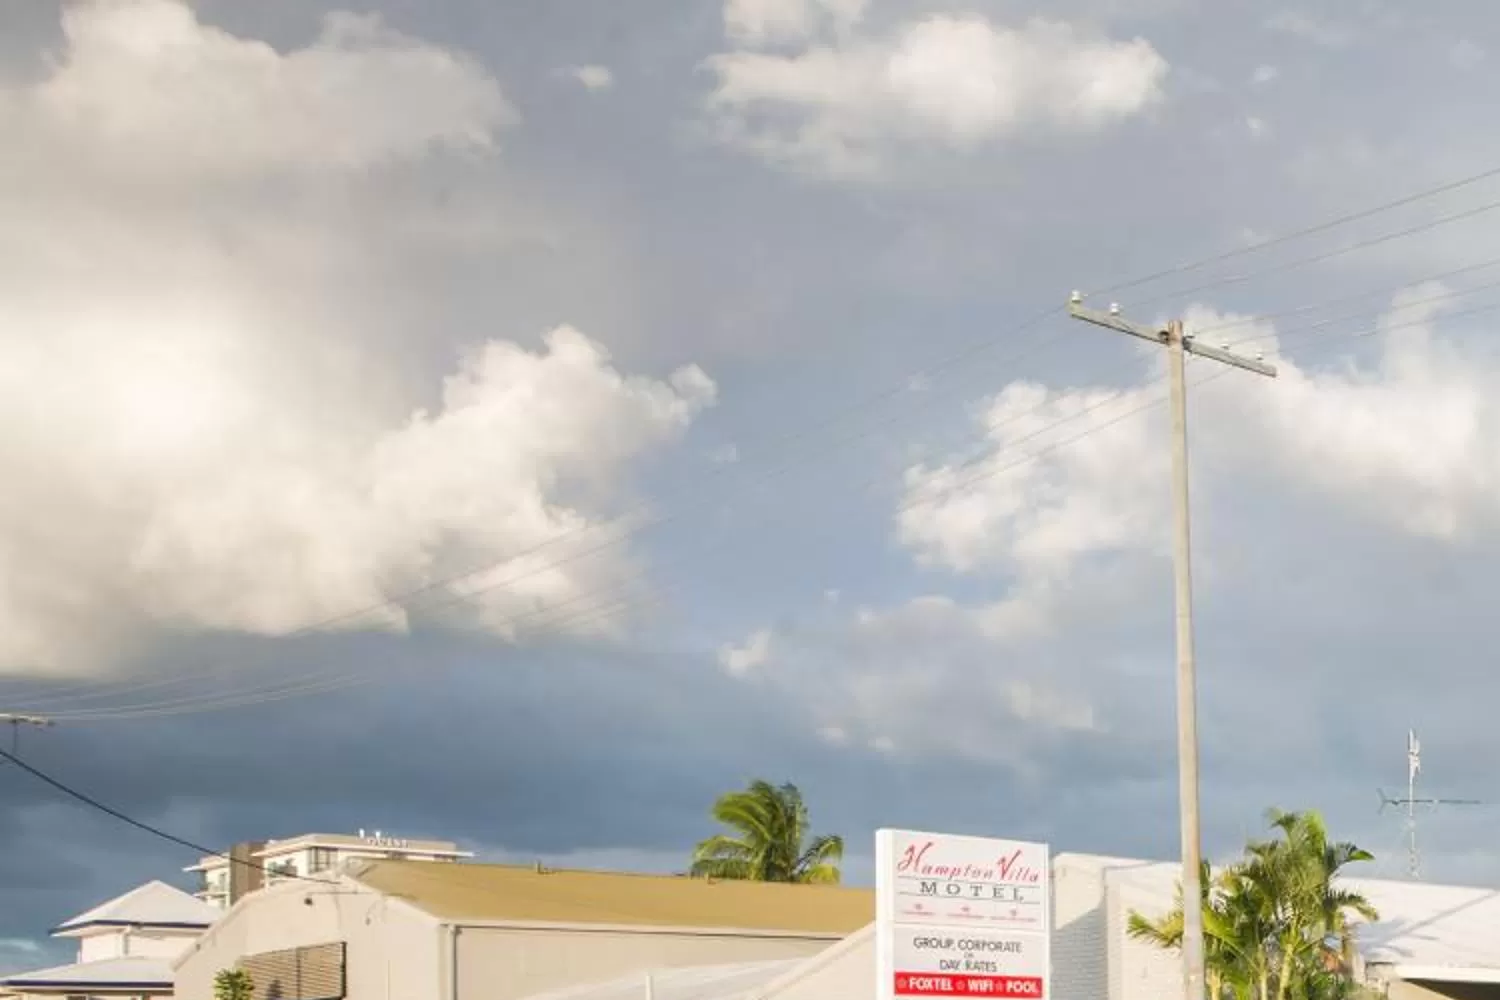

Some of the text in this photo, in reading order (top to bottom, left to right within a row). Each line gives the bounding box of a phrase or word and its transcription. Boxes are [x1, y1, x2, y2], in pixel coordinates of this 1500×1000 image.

[897, 841, 1040, 882] Hampton Villa
[919, 881, 1024, 900] MOTEL
[957, 939, 1022, 953] CORPORATE
[939, 959, 998, 973] DAY RATES
[909, 977, 1039, 993] FOXTEL WIFI POOL
